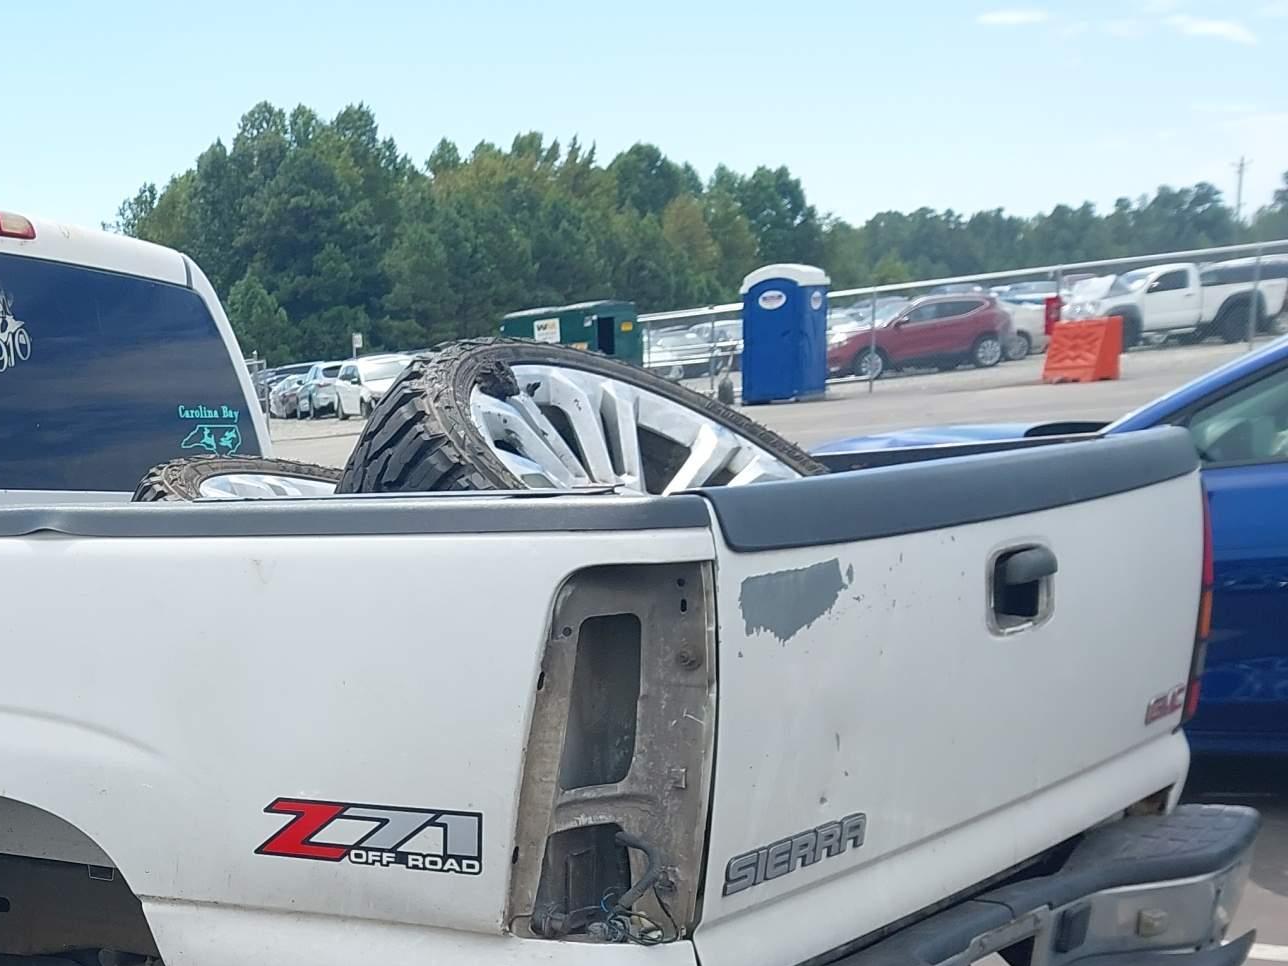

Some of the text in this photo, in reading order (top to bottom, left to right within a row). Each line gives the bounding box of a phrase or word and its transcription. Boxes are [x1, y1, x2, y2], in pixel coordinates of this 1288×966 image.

[178, 405, 239, 423] Carolina Bay
[254, 797, 483, 862] Z71
[349, 850, 481, 874] OFF ROAD
[722, 812, 867, 898] SIERRA
